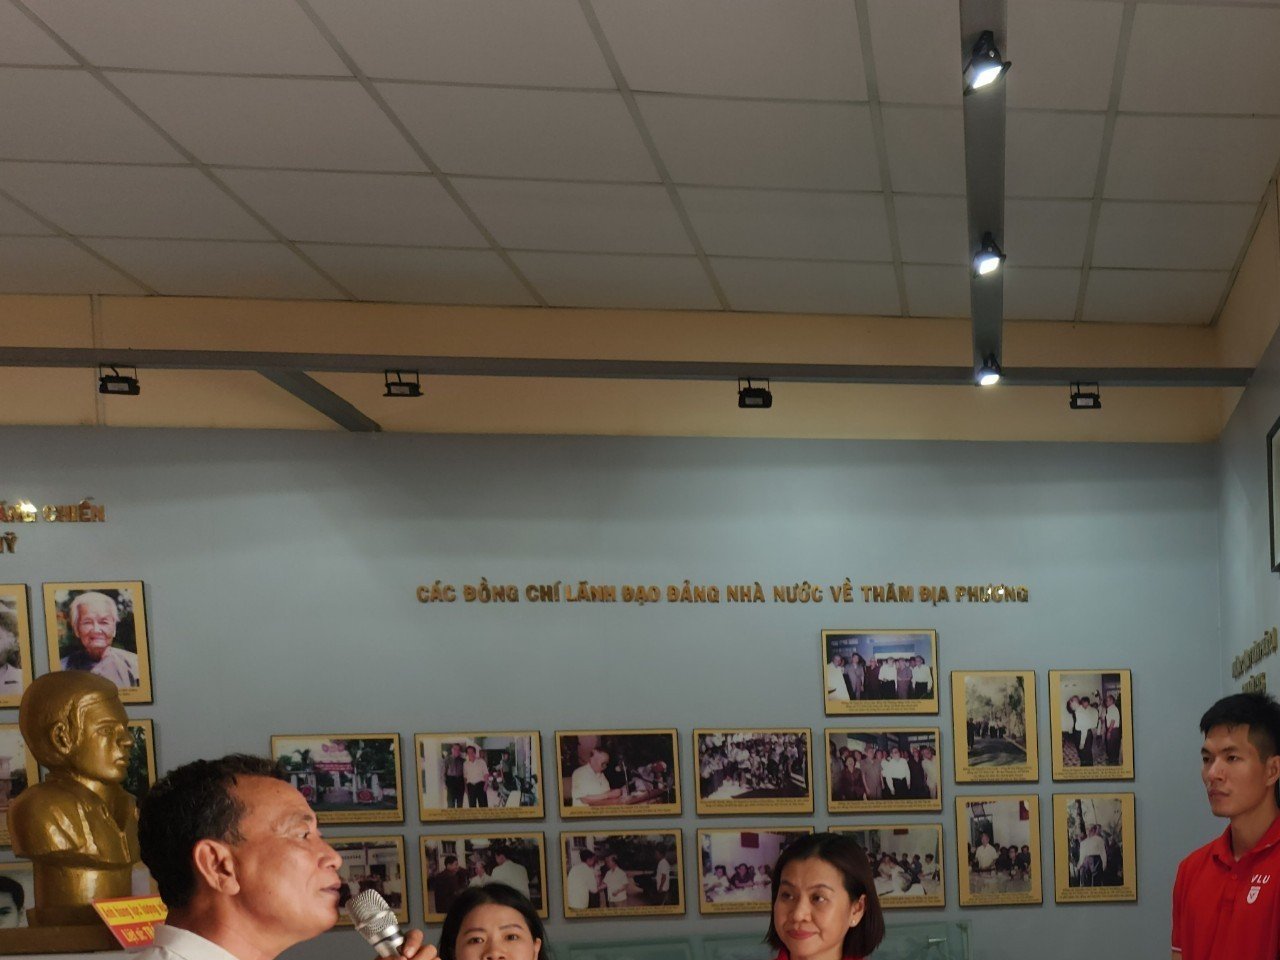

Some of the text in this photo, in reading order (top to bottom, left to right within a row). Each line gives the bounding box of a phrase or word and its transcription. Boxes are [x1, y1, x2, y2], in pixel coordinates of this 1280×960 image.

[416, 577, 1029, 606] CÁC ĐỒNG CHÍ LÃNH ĐẠO ĐẢNG NHÀ NƯỚC VỀ THĂM ĐỊA PHƯƠNG
[1251, 874, 1270, 884] VLU
